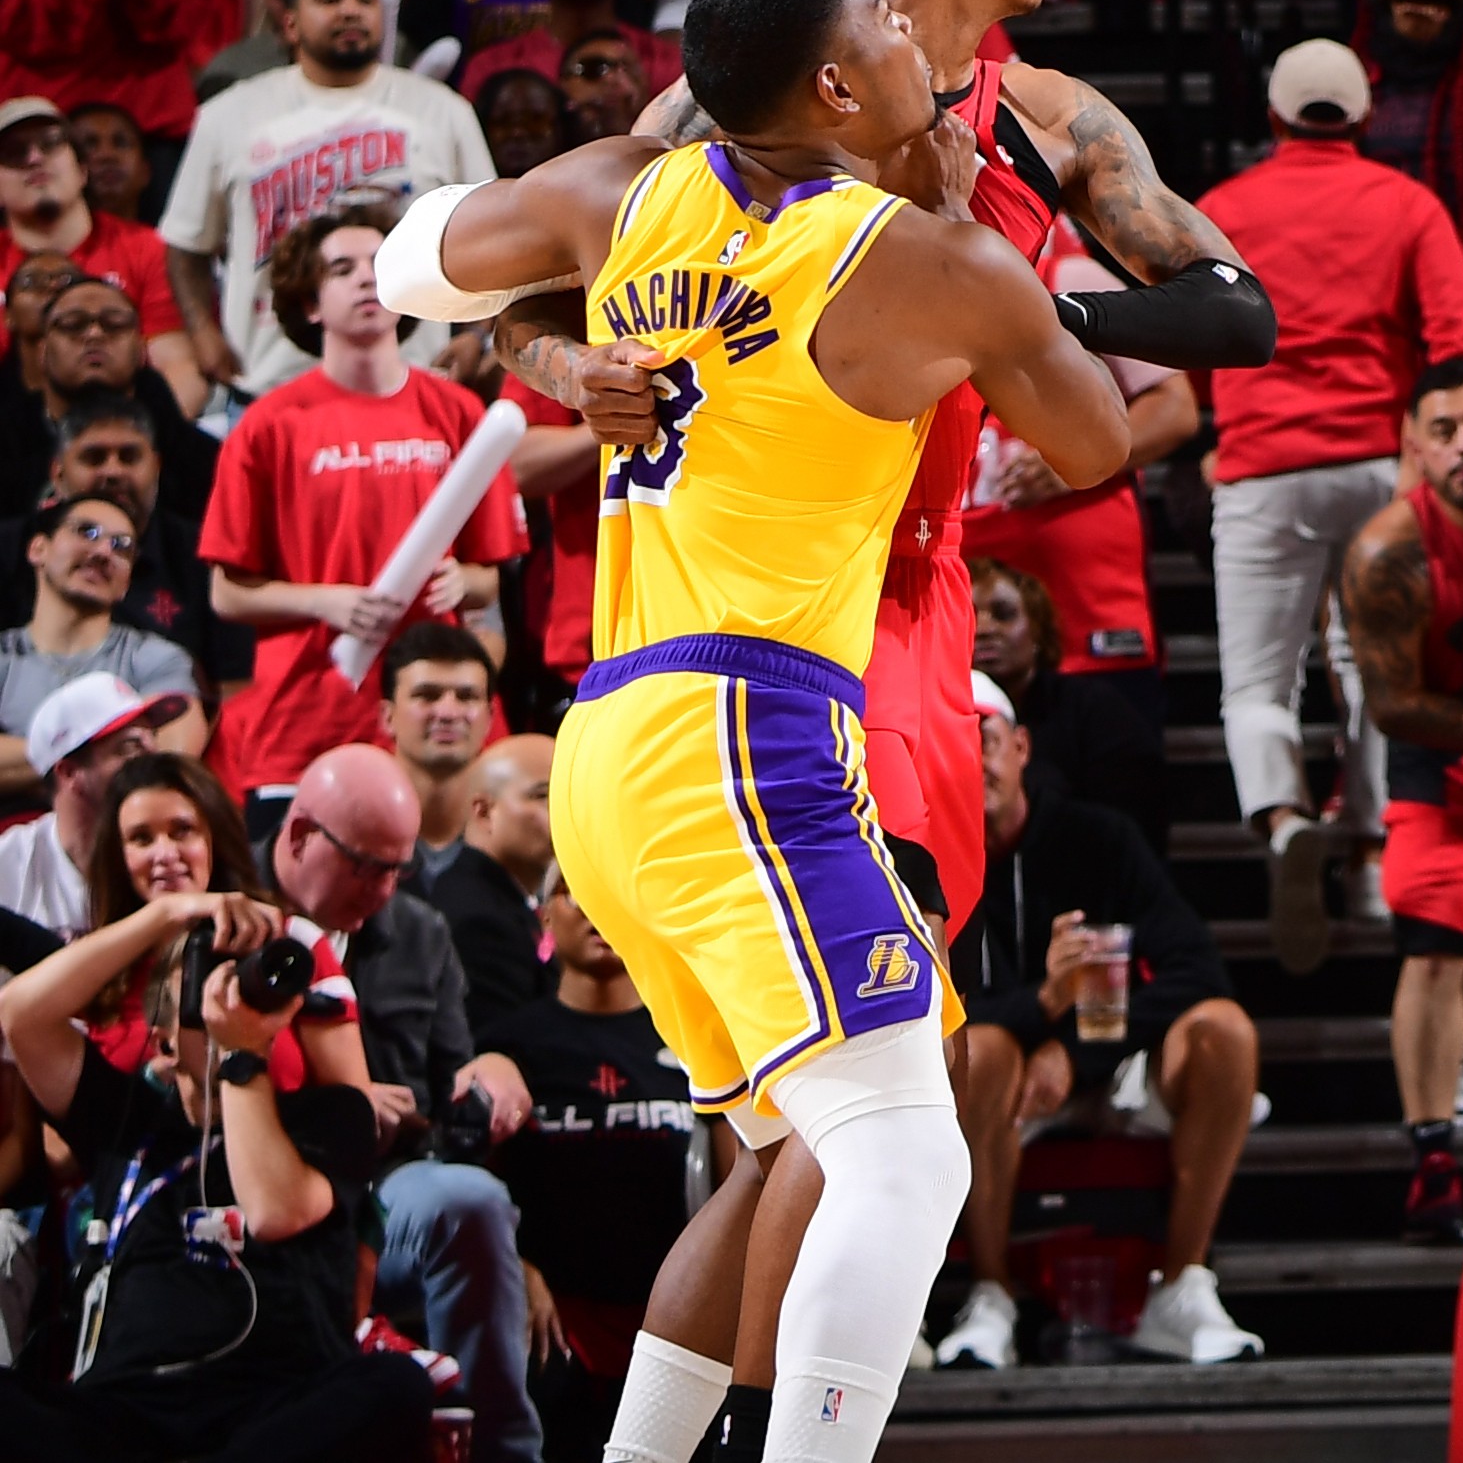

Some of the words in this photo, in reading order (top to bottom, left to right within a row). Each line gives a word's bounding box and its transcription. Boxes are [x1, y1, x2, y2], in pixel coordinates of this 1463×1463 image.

[251, 130, 407, 264] HOUSTON
[602, 269, 780, 366] HACHIRA
[310, 441, 372, 475] ALL
[603, 357, 708, 517] 8
[535, 1103, 594, 1133] LL
